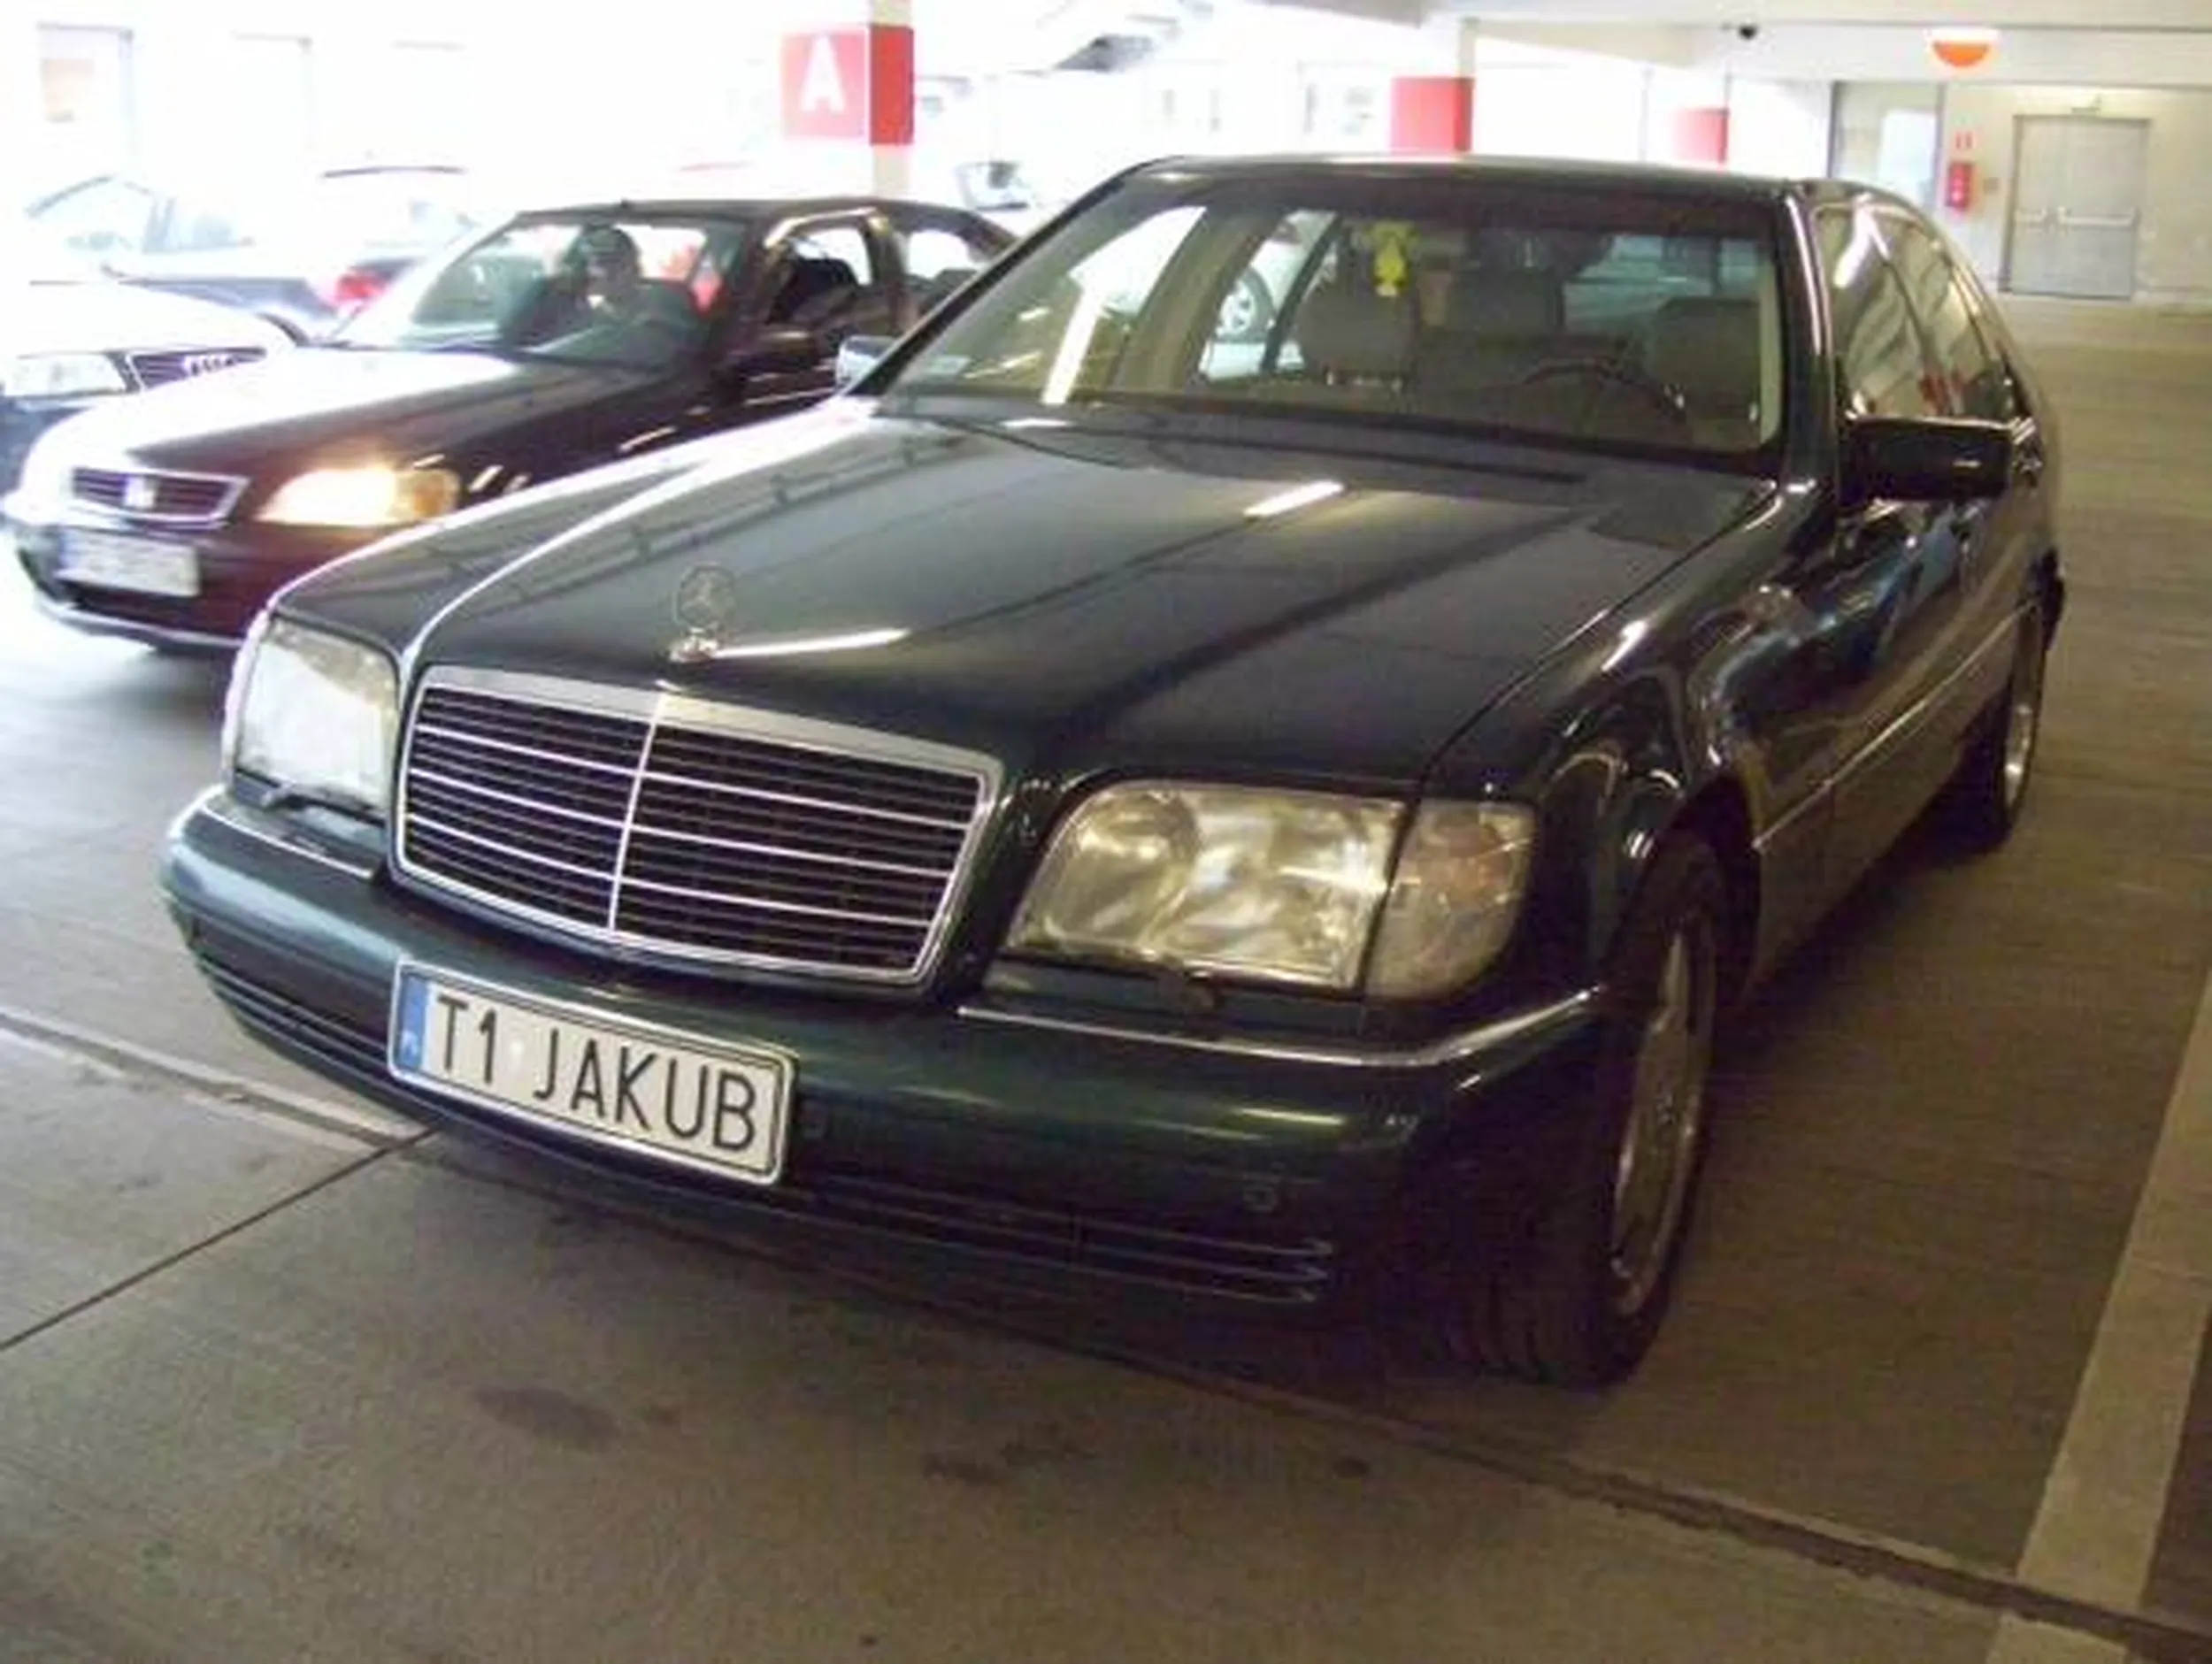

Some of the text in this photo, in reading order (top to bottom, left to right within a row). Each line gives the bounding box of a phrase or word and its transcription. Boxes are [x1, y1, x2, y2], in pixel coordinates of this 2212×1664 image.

[801, 34, 845, 113] A
[437, 993, 757, 1152] T1 JAKUB
